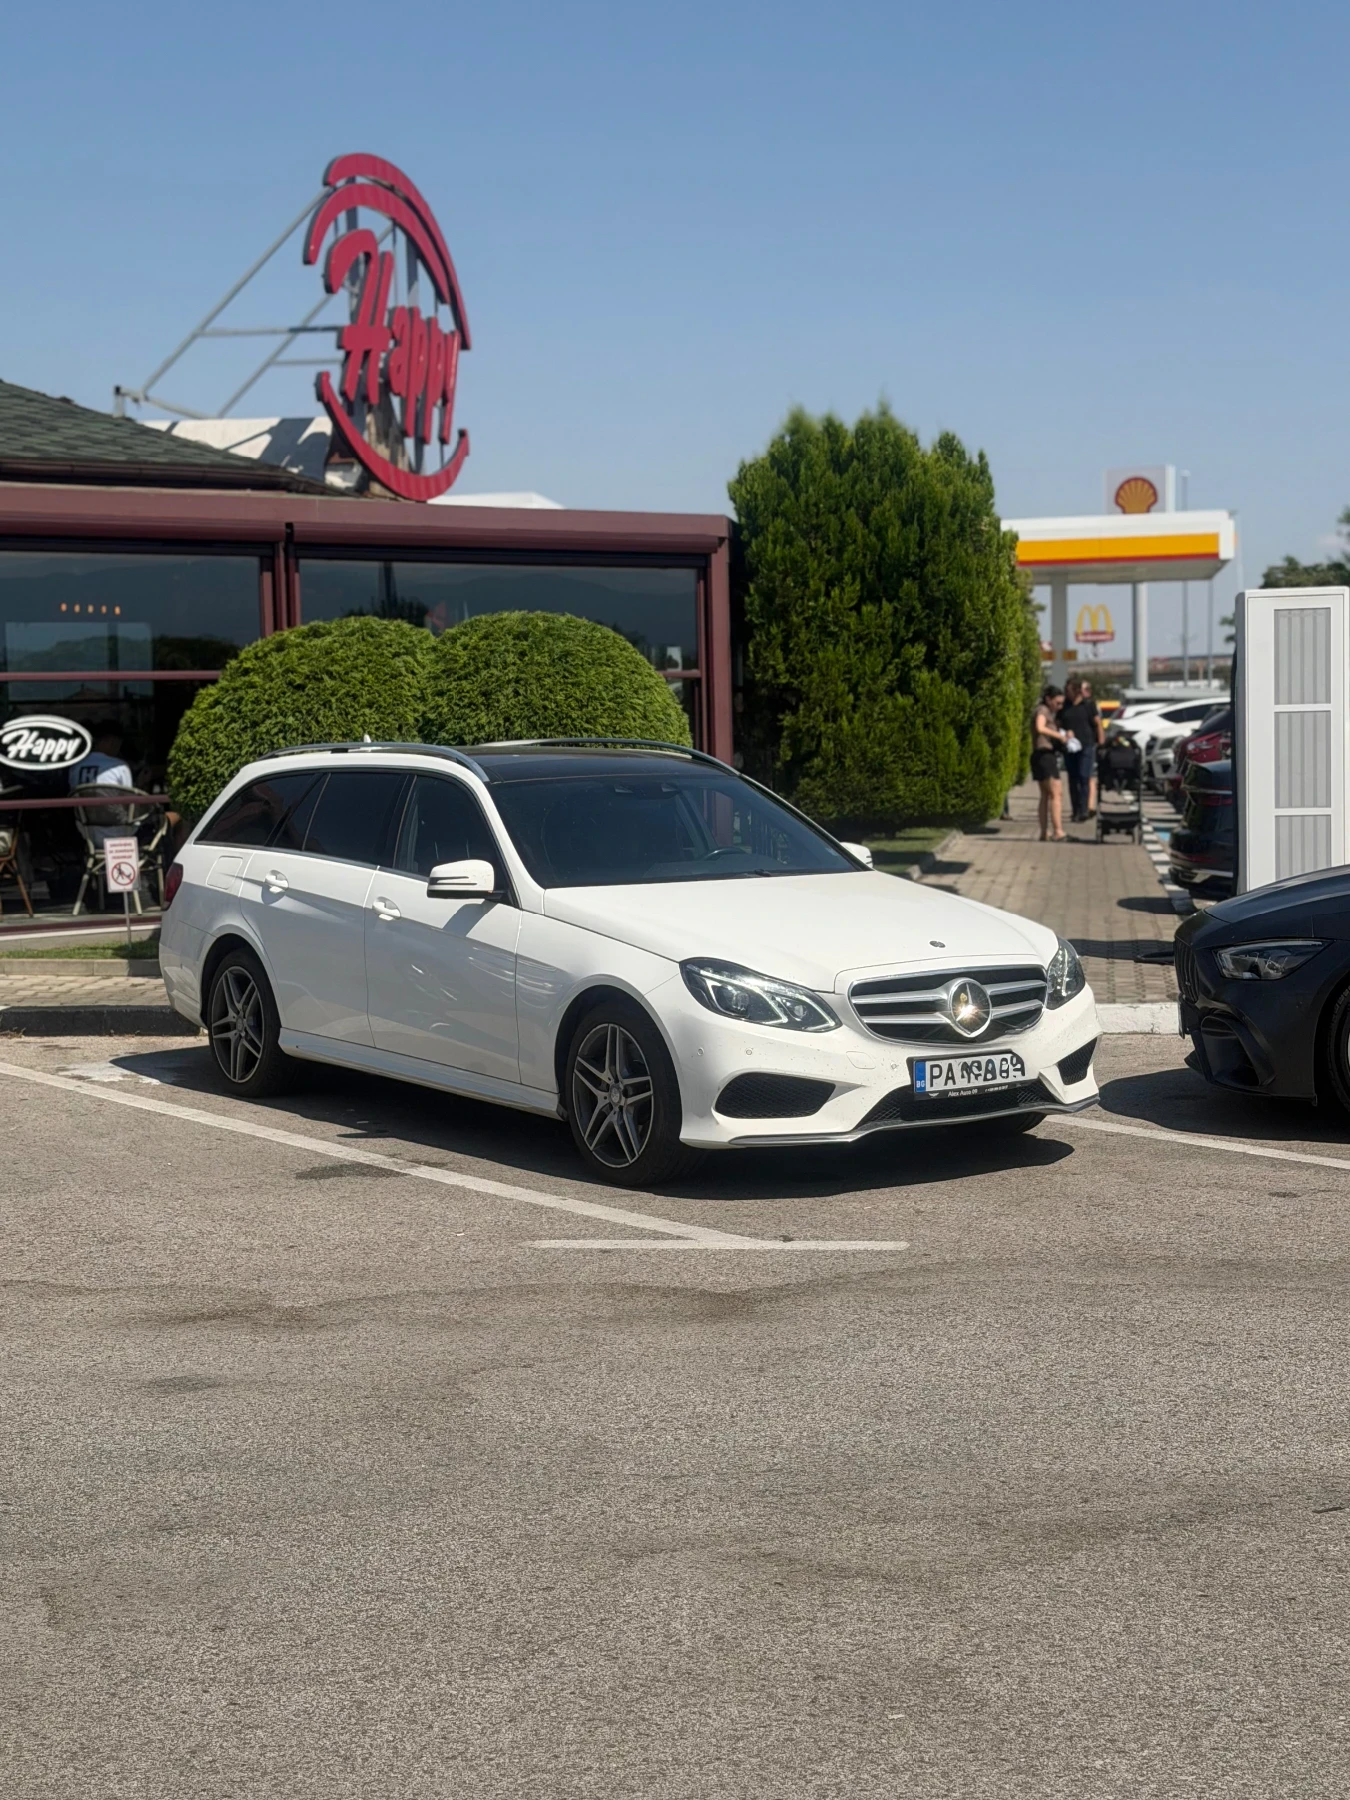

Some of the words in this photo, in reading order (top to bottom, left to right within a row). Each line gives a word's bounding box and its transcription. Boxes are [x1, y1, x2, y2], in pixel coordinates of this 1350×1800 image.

[325, 229, 461, 445] Happy
[1, 728, 82, 762] Happy
[916, 1079, 925, 1088] BG
